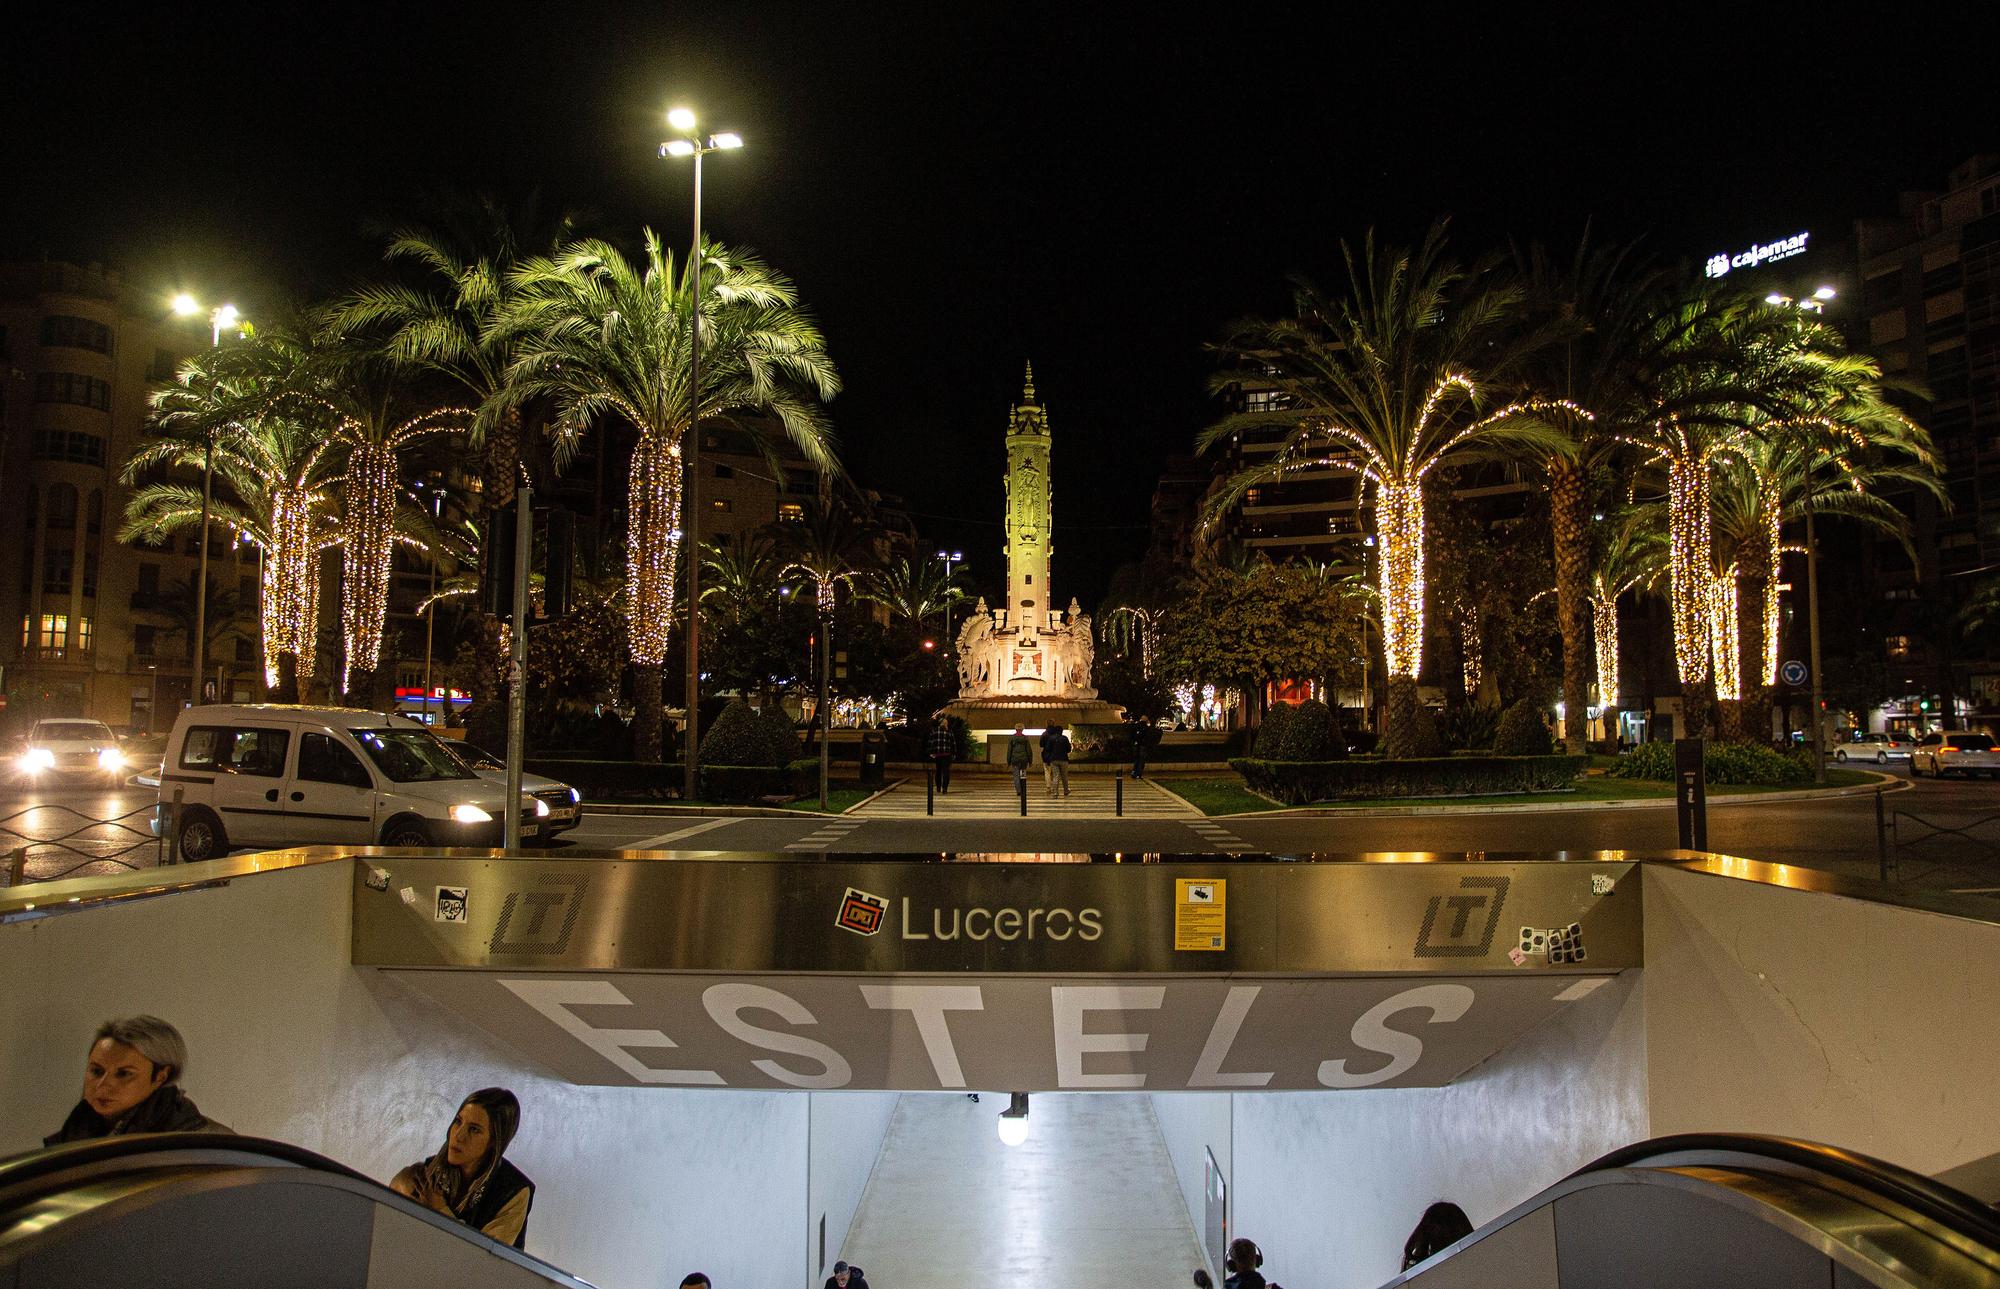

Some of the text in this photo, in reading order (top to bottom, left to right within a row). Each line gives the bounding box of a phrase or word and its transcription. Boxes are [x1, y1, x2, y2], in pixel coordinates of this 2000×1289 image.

[1731, 232, 1809, 267] cajamar
[902, 896, 1104, 942] Luceros
[496, 979, 1475, 1089] ESTELS
